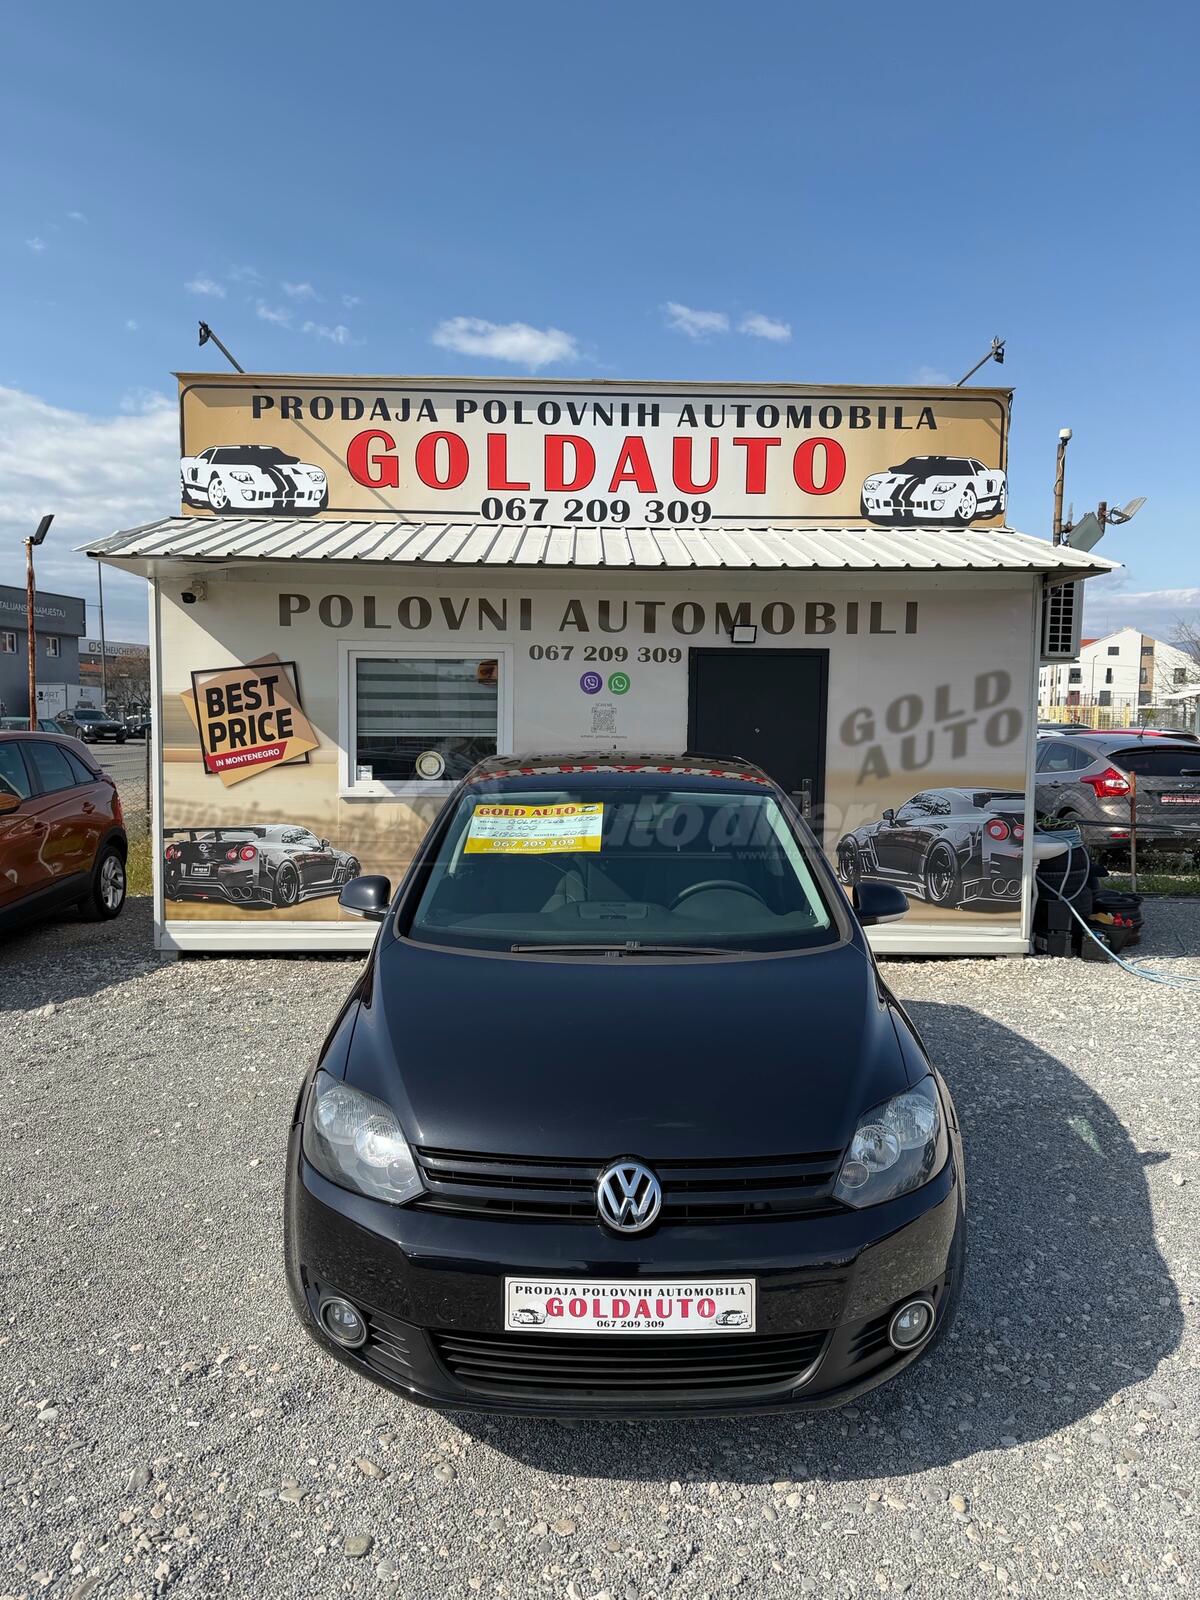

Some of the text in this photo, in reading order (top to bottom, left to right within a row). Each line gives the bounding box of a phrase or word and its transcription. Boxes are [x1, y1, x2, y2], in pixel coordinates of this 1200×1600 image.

[251, 395, 938, 430] PRODAJA POLOVNIH AUTOMOBILA
[346, 429, 847, 496] GOLDAUTO
[480, 497, 712, 524] 067 209 309
[278, 593, 918, 635] POLOVNI AUTOMOBILI
[528, 644, 683, 663] 067 209 309
[205, 675, 279, 719] BEST
[839, 669, 1012, 747] GOLD
[207, 707, 294, 753] PRICE
[215, 748, 281, 767] IN MONTENEGRO
[855, 706, 1023, 787] AUTO
[478, 806, 577, 817] GOLD AUTO
[493, 839, 576, 848] 067 209 309
[600, 1165, 659, 1230] VW
[515, 1285, 747, 1298] PRODAJA POLOVNIH AUTOMOBILA
[545, 1297, 717, 1319] GOLDAUTO
[596, 1320, 665, 1328] 067 209 309
